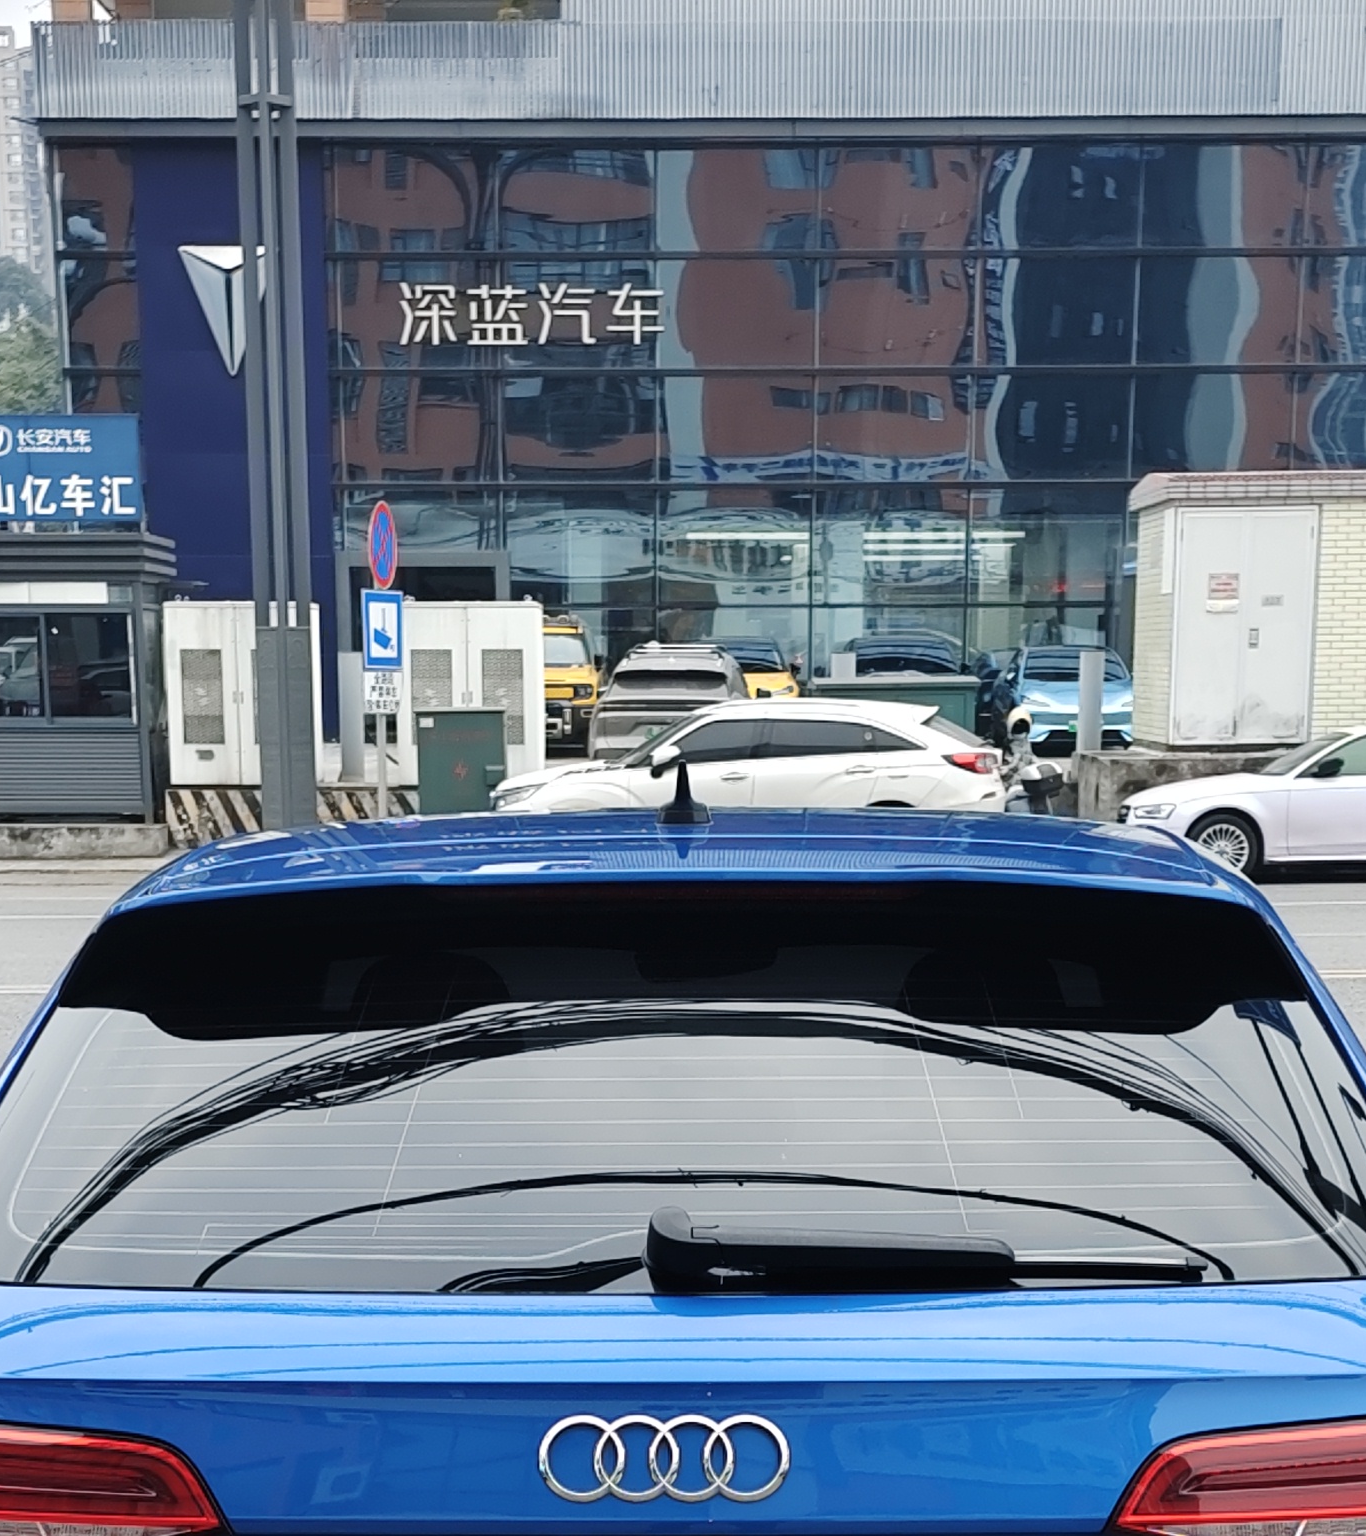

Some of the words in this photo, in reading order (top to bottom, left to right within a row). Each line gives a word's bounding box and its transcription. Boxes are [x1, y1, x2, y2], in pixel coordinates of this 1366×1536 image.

[399, 281, 665, 346] 深蓝汽车
[17, 428, 92, 446] 长安汽车
